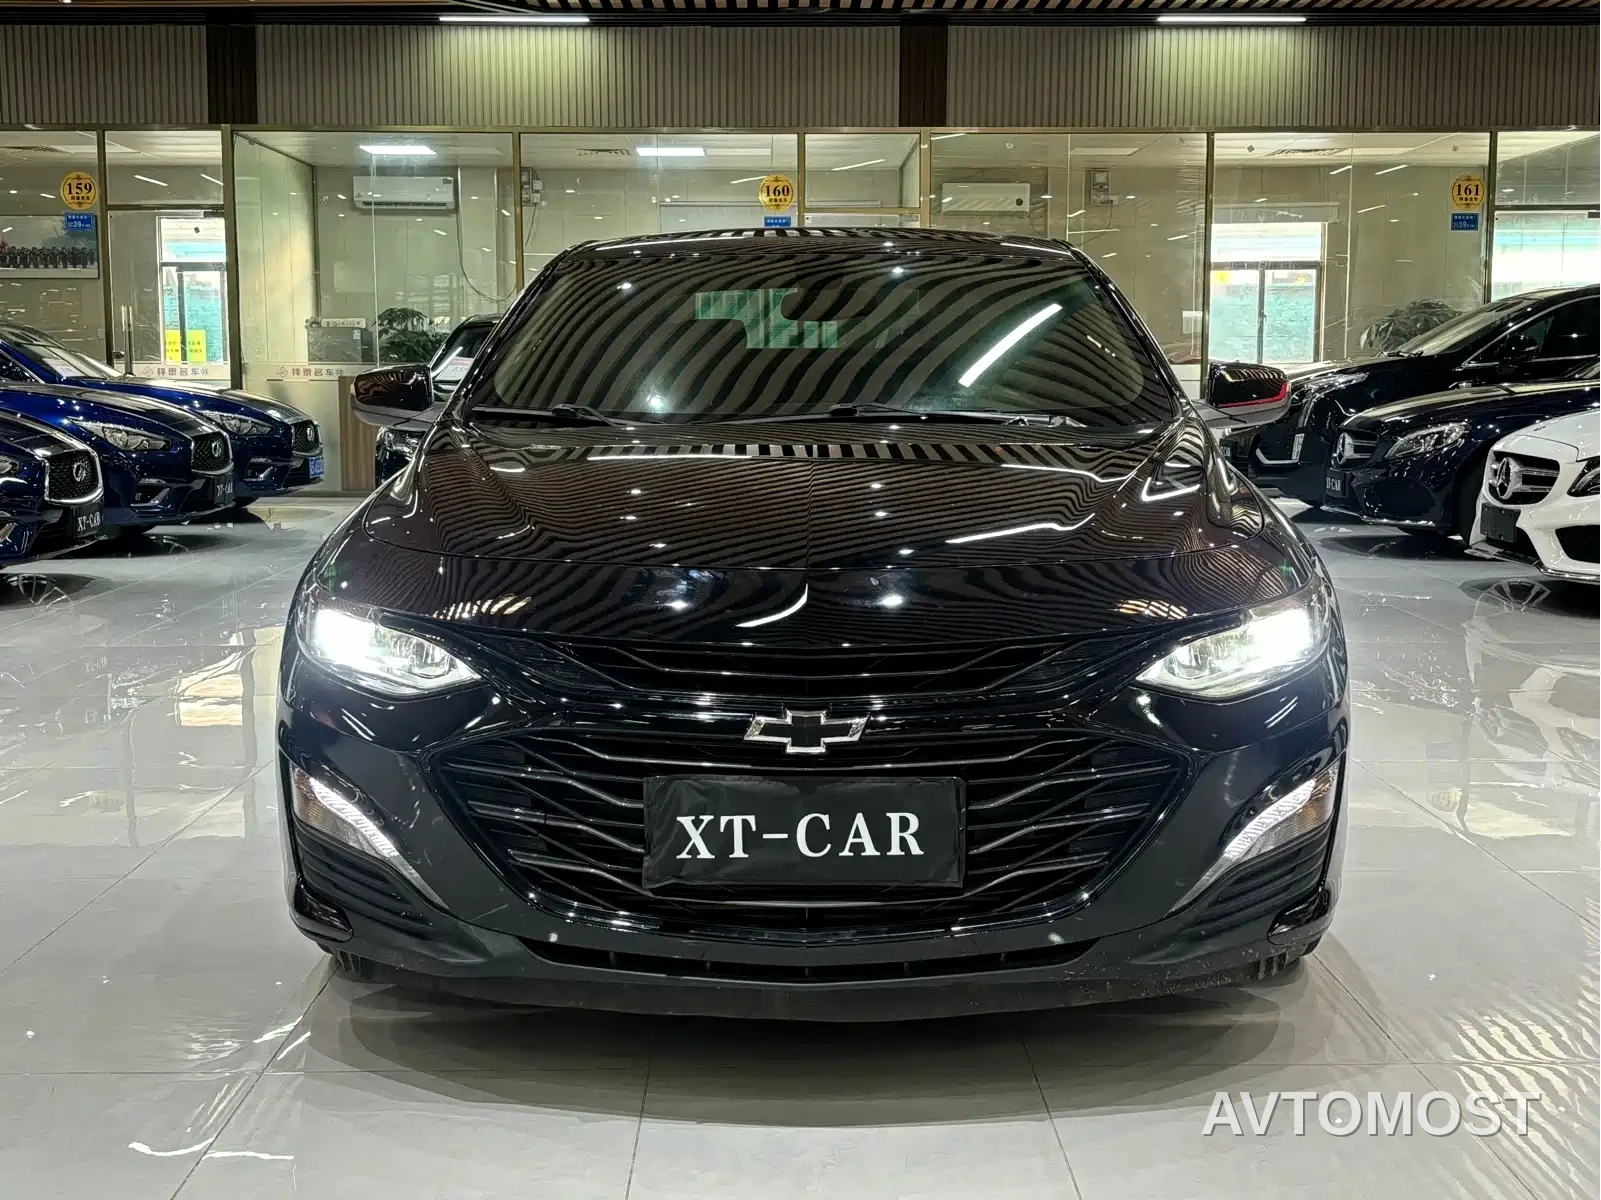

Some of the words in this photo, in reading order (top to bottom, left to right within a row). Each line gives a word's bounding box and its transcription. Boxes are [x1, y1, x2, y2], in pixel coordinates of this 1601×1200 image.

[67, 182, 92, 195] 159
[764, 184, 790, 197] 160
[1456, 183, 1480, 196] 161
[675, 812, 924, 860] XT-CAR
